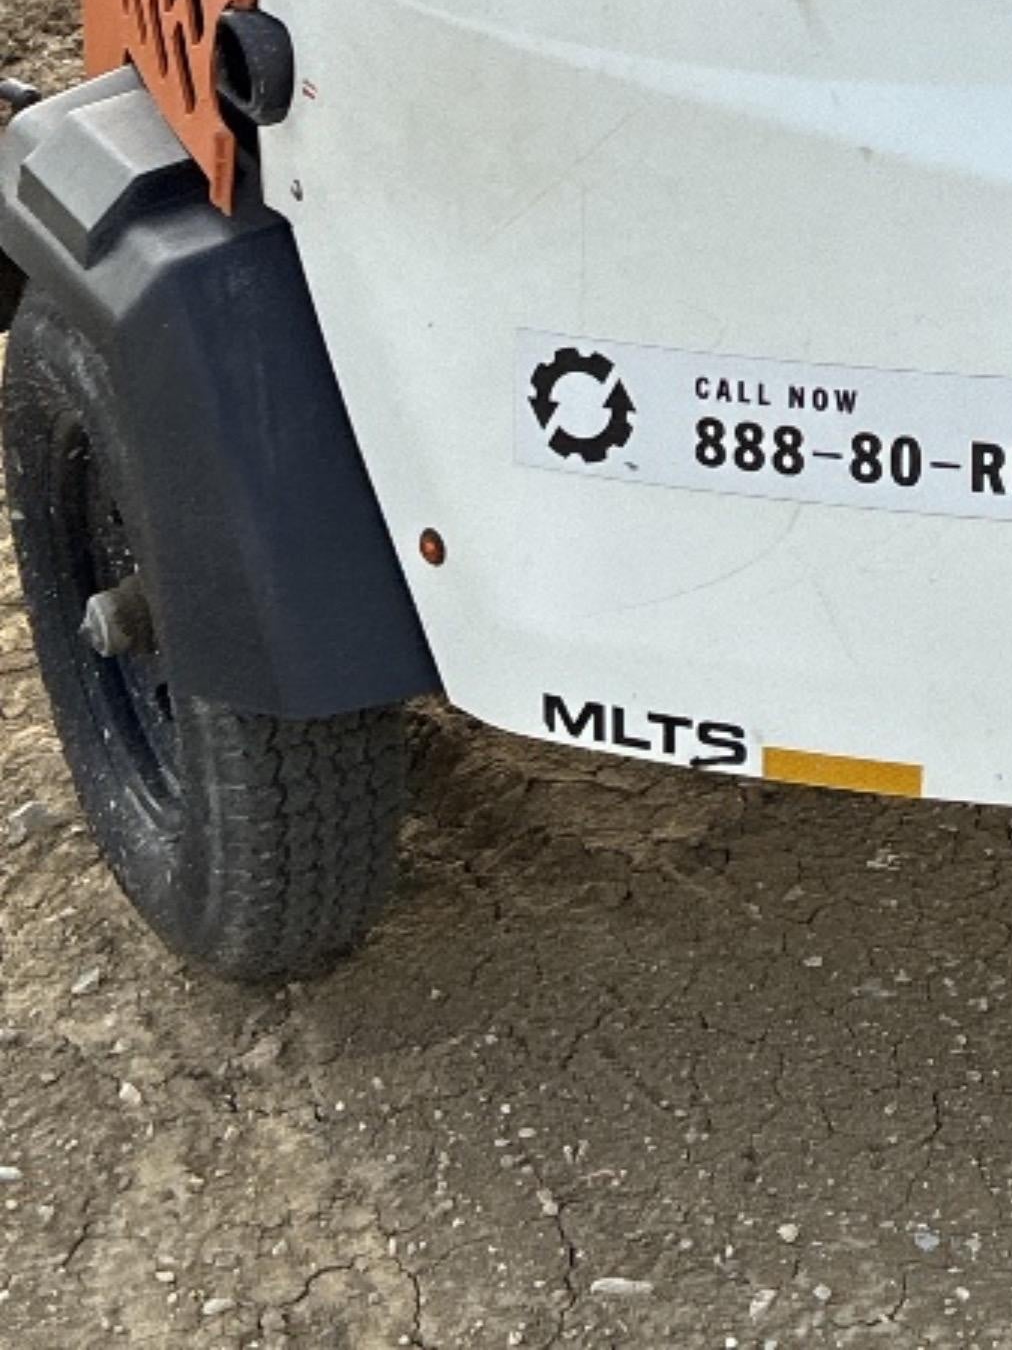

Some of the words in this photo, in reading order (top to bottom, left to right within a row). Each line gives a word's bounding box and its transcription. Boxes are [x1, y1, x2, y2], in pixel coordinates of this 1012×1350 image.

[694, 376, 771, 408] CALL
[788, 385, 858, 415] NOW
[542, 692, 748, 769] MLTS
